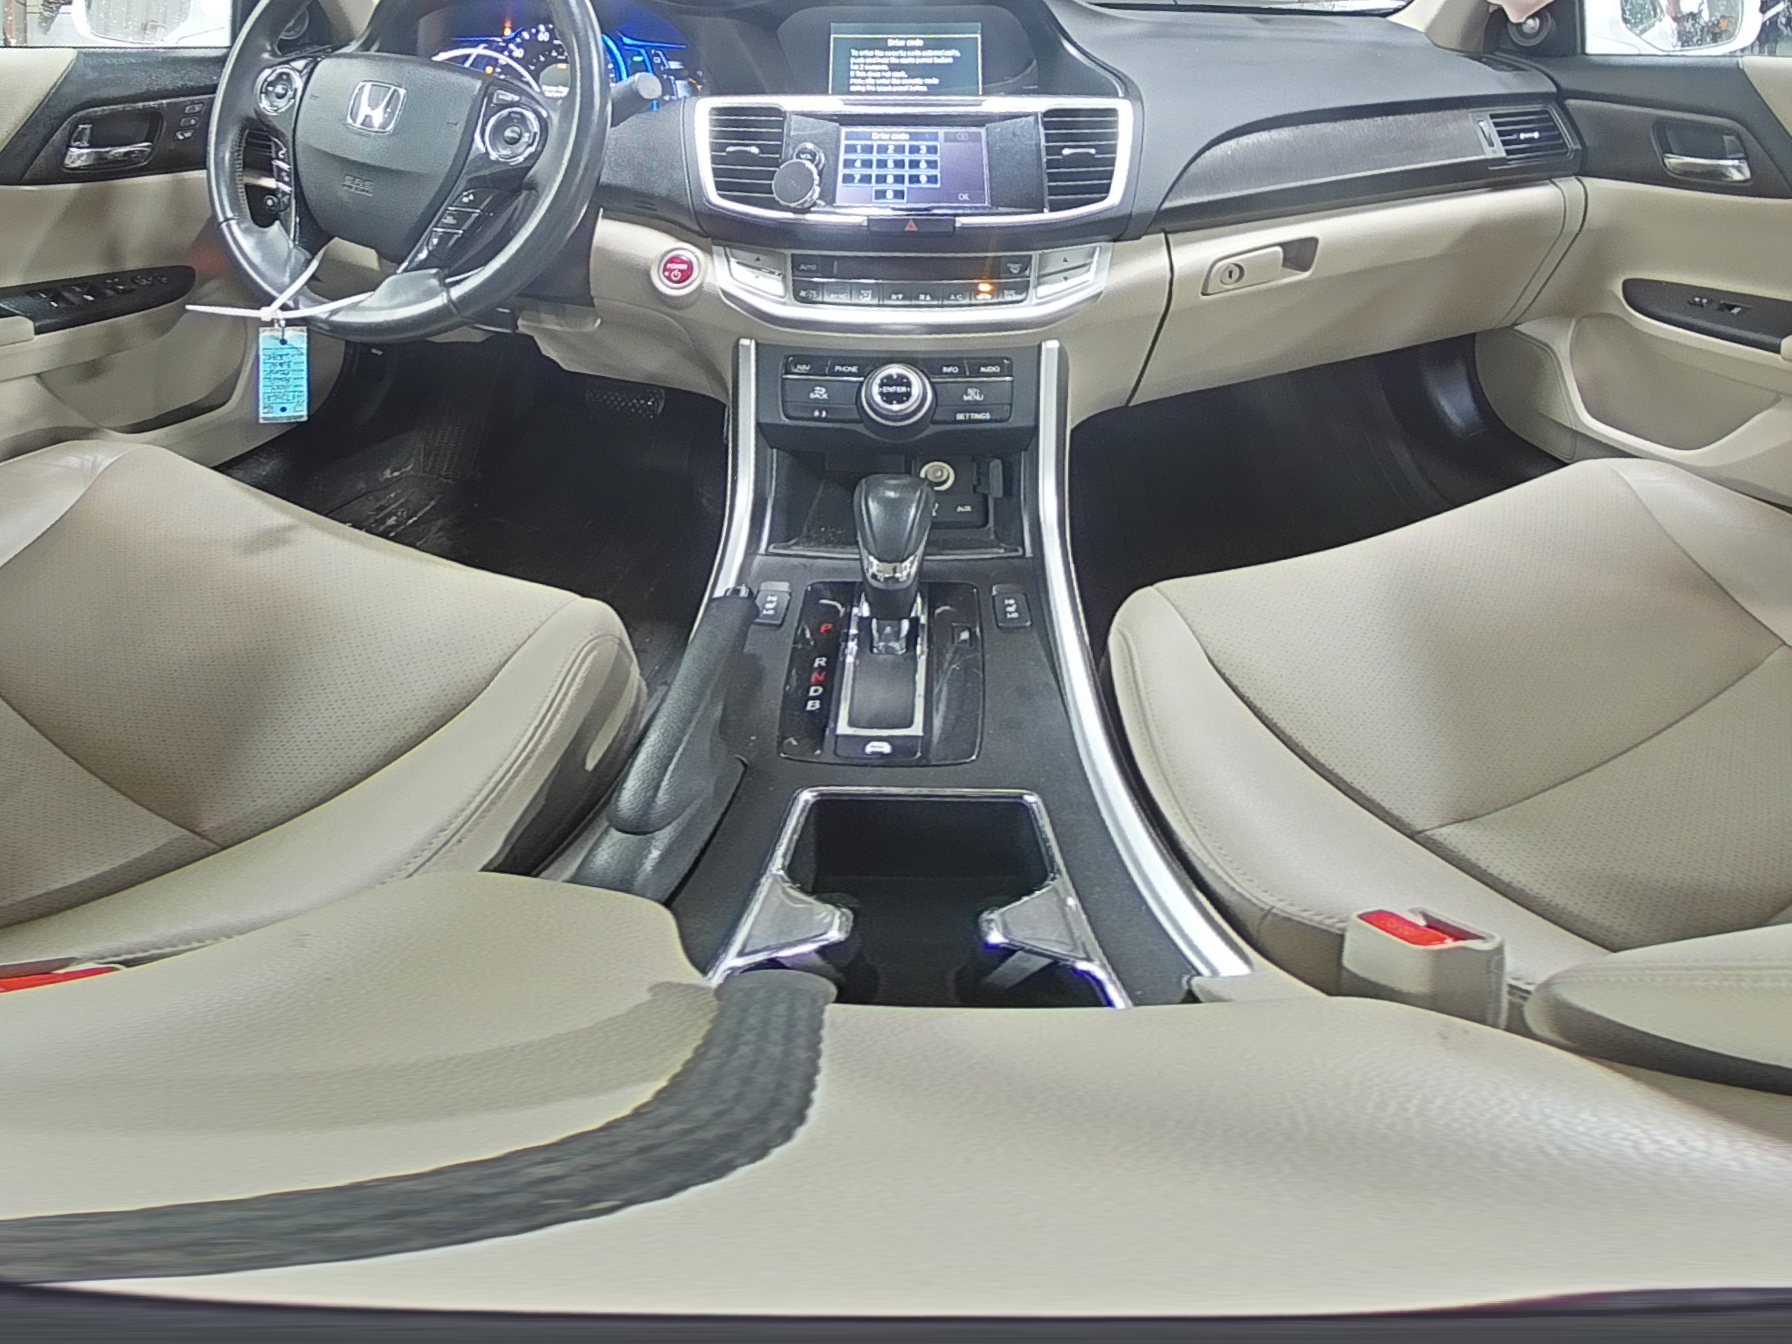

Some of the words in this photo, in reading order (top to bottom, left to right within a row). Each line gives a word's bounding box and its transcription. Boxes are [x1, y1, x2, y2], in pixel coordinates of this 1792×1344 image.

[906, 39, 924, 47] code
[856, 144, 862, 154] 1
[887, 144, 895, 154] 2
[919, 144, 927, 154] 3
[854, 159, 862, 169] 4
[887, 159, 895, 169] 5
[919, 159, 928, 169] 6
[853, 174, 861, 184] 7
[886, 174, 894, 185] 8
[919, 174, 928, 185] 9
[886, 189, 894, 200] 0
[958, 192, 970, 201] OK
[834, 365, 859, 373] PHONE
[955, 412, 991, 421] SETTINGS
[819, 623, 834, 633] P
[813, 657, 828, 668] R
[810, 673, 826, 683] N
[808, 686, 823, 697] D
[805, 700, 821, 711] B
